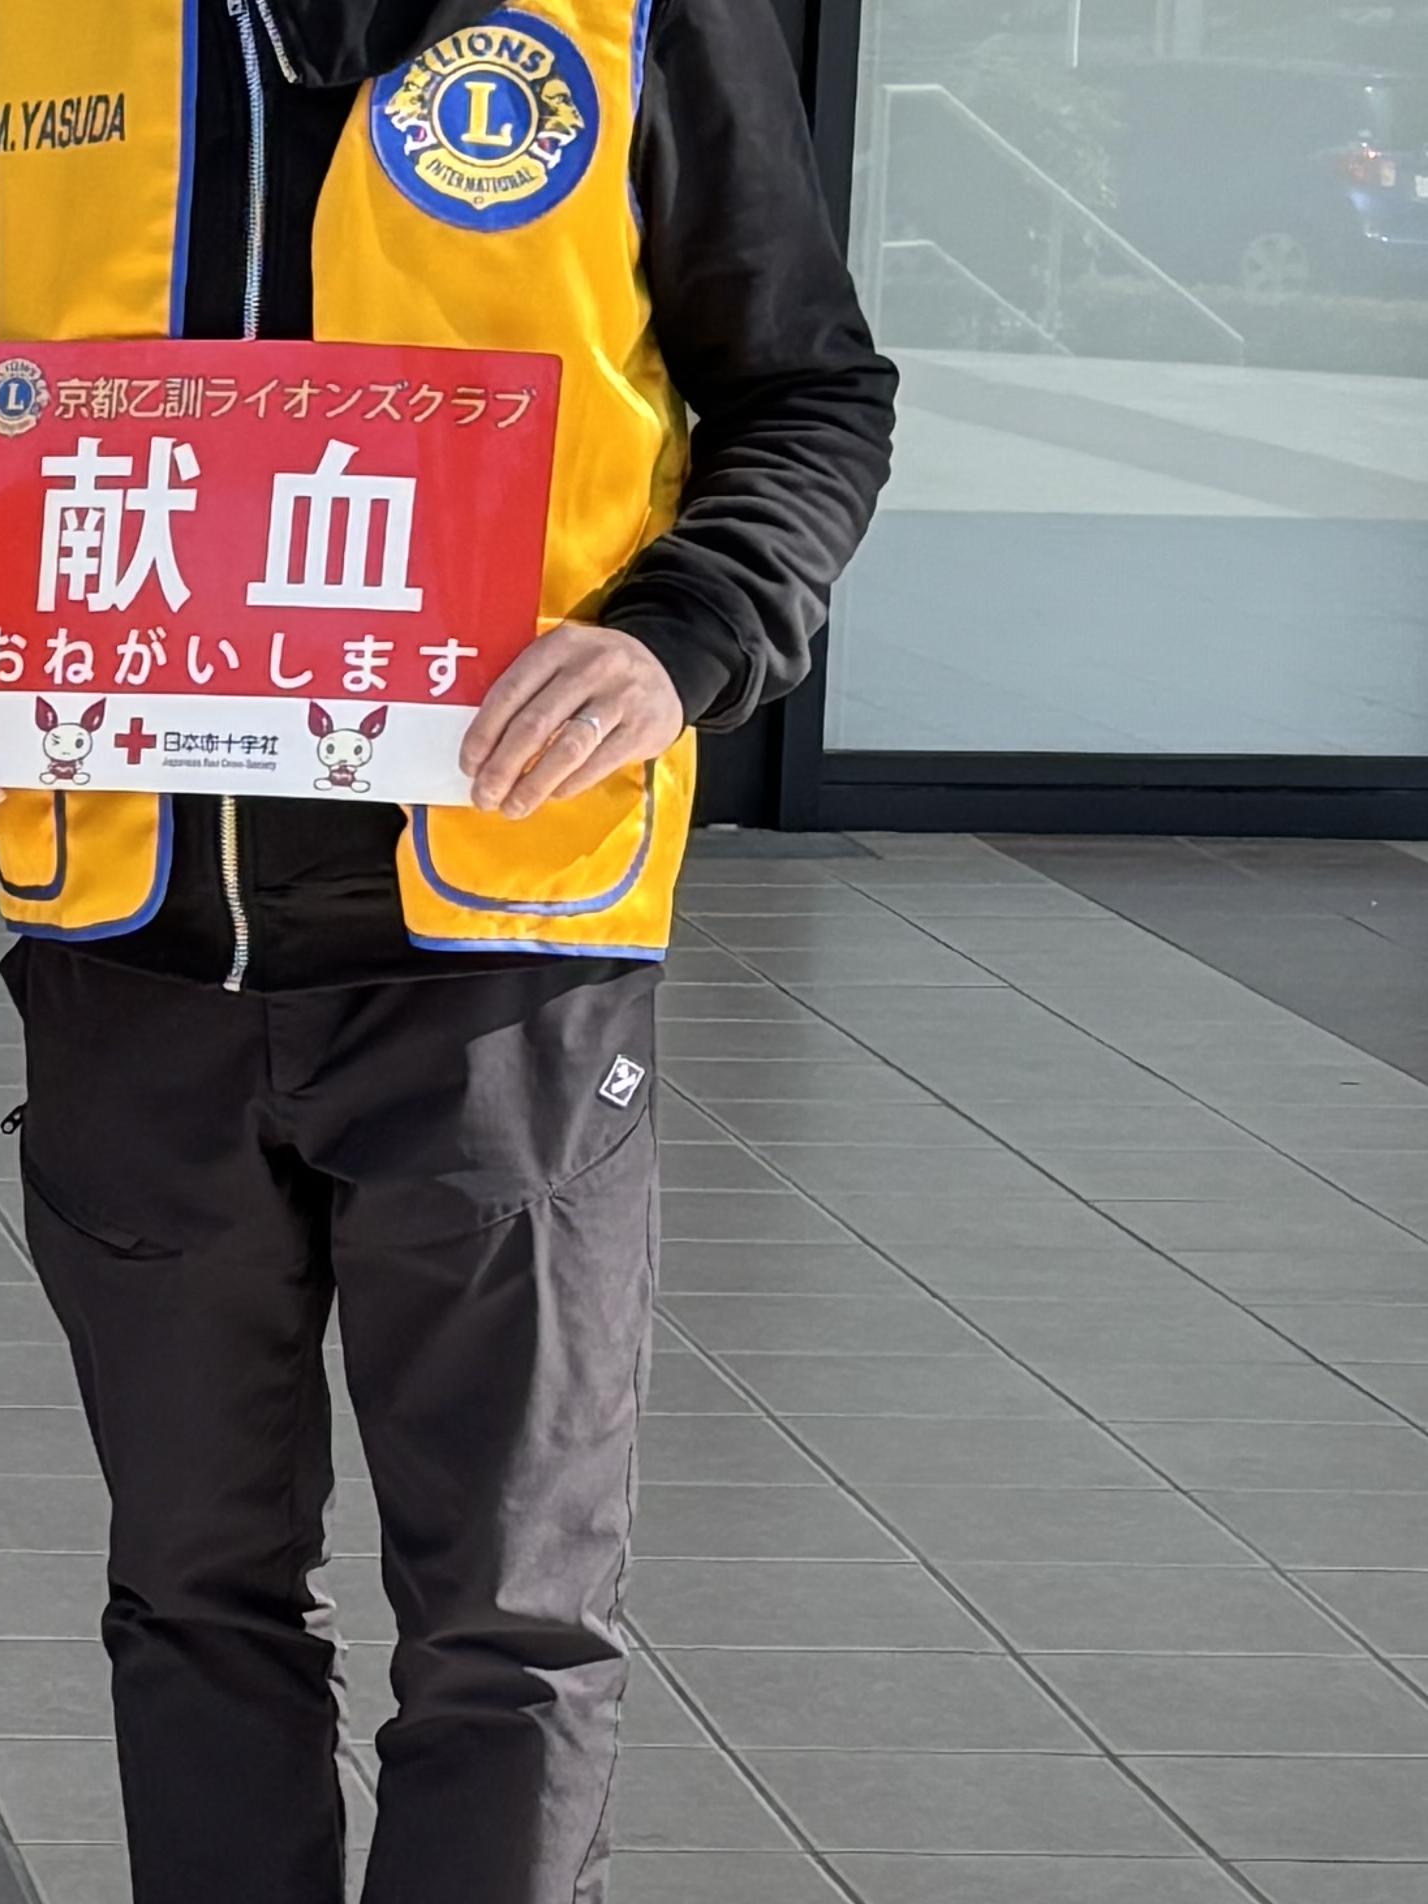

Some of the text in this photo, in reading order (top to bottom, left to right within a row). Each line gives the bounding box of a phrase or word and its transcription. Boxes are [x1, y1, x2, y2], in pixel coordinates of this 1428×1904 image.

[431, 33, 546, 73] LIONS
[461, 81, 513, 147] L
[425, 159, 539, 194] INTERNATIONAL
[56, 375, 537, 429] 京都乙訓ライオンズクラブ
[37, 436, 424, 614] 献血
[163, 731, 279, 755] 日本赤十字社
